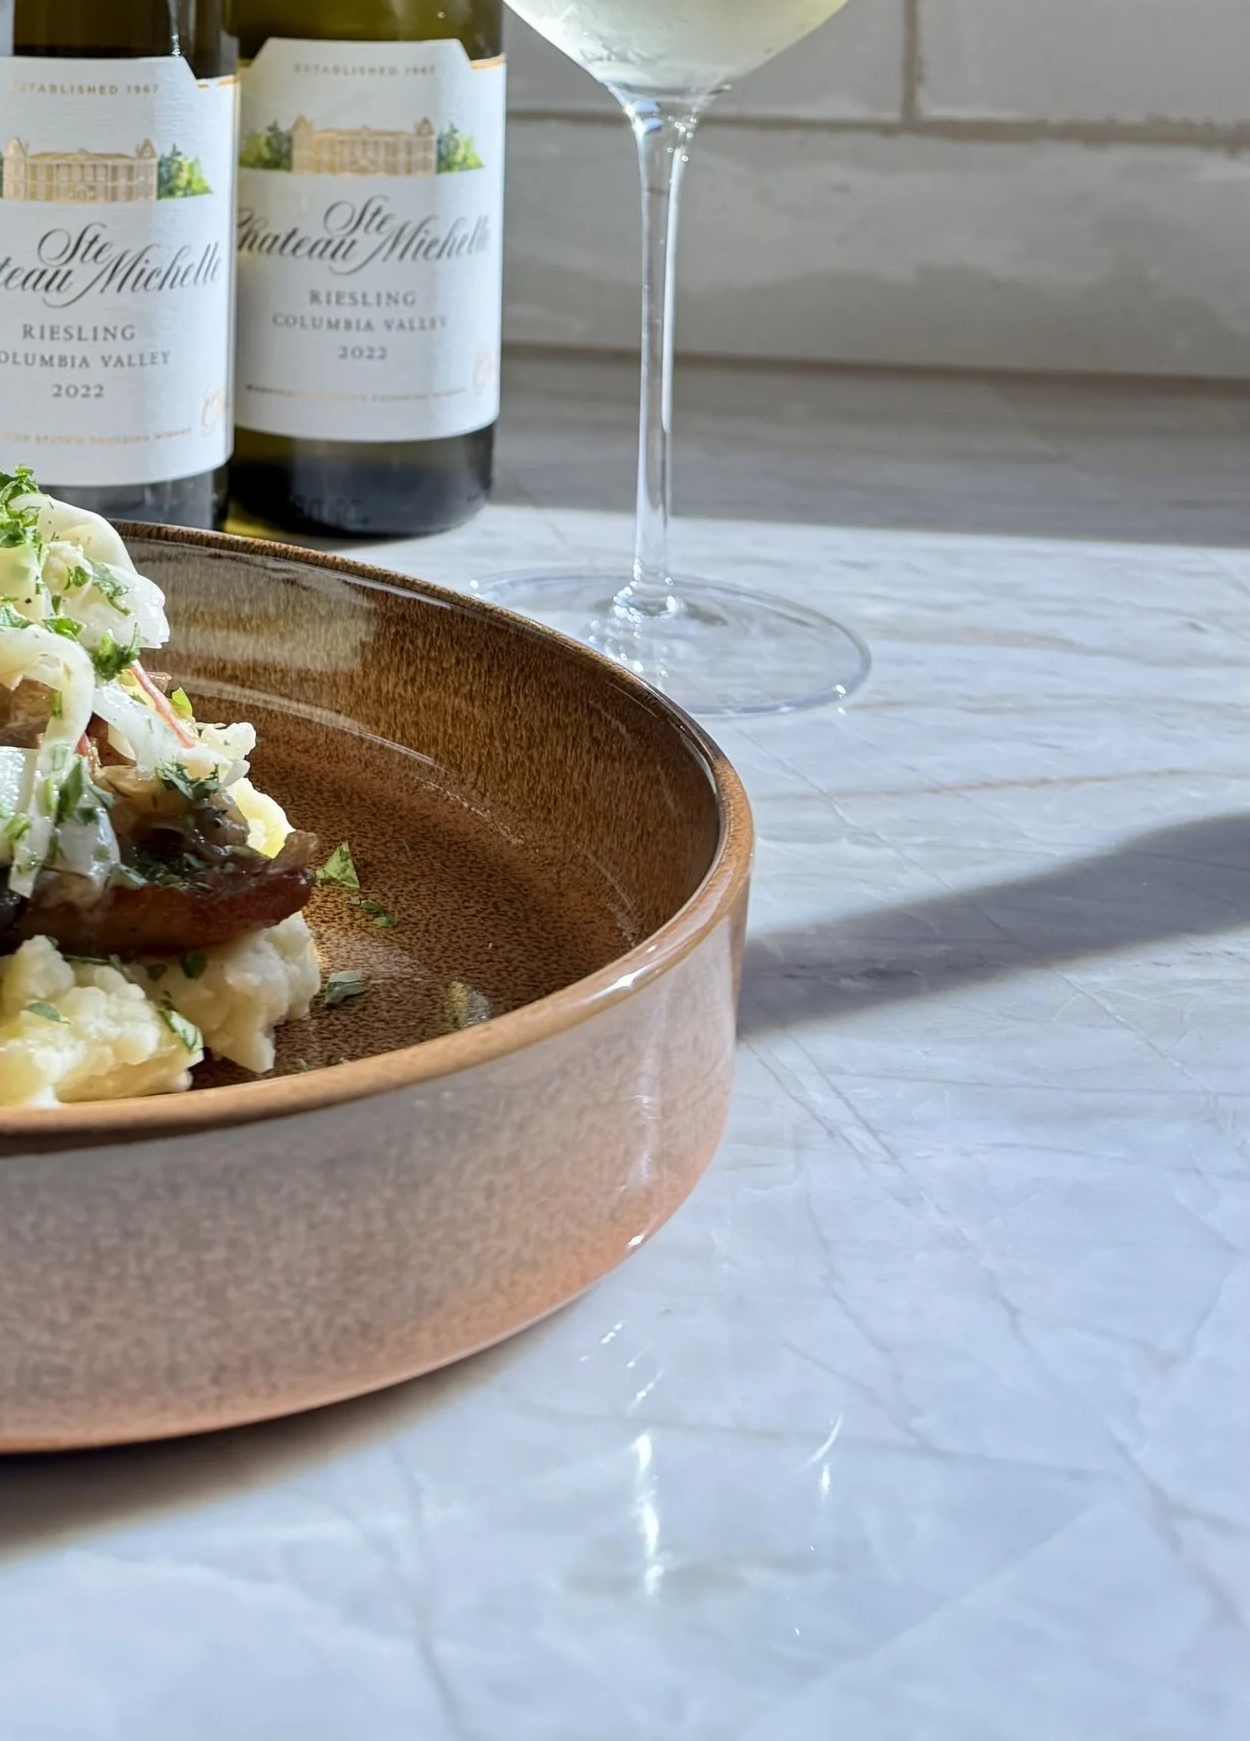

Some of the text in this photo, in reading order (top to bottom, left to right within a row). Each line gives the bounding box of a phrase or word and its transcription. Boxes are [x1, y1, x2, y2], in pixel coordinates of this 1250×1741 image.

[324, 194, 393, 236] Ste
[38, 222, 113, 268] Ste
[309, 290, 417, 308] RIESLING
[22, 322, 137, 342] RIESLING
[272, 314, 448, 333] COLUMBIA VALLEY
[100, 349, 172, 368] VALLEY
[338, 346, 389, 361] 2022
[51, 383, 106, 400] 2022
